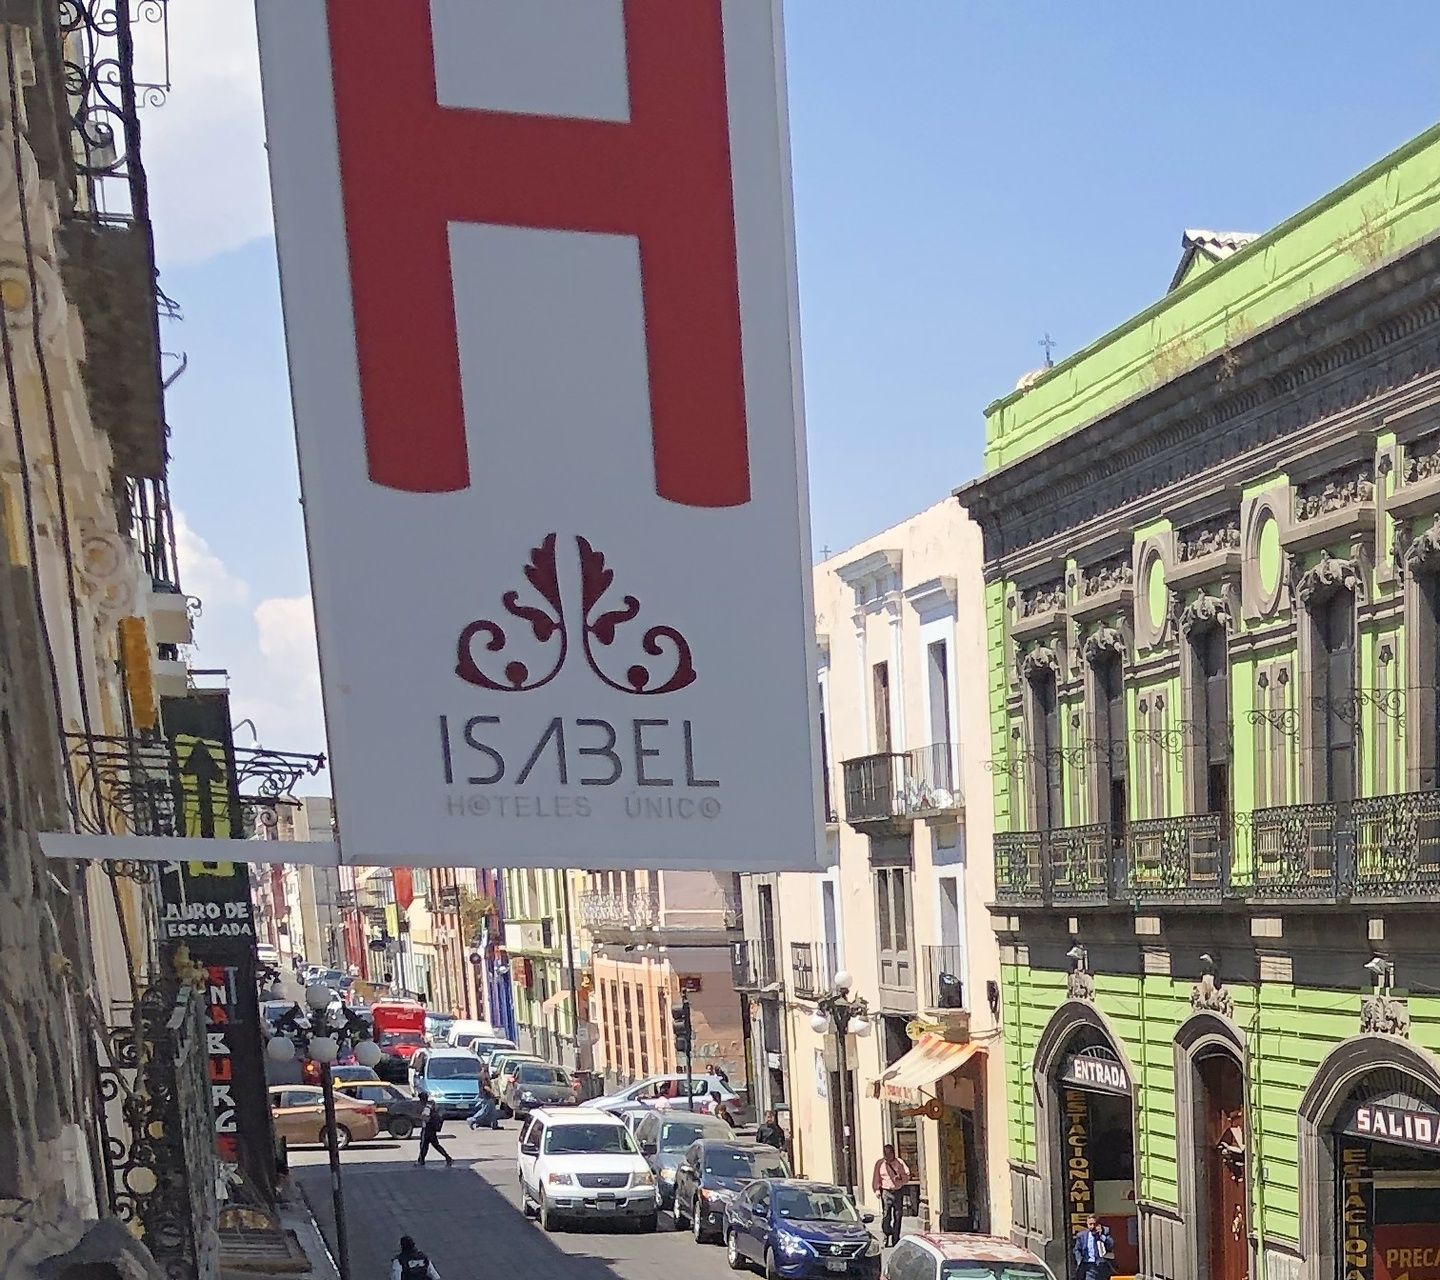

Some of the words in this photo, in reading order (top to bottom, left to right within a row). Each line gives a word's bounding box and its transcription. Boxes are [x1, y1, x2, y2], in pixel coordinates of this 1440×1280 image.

[328, 0, 751, 508] H
[440, 715, 720, 787] ISABEL
[167, 923, 252, 937] ESCALADA
[224, 902, 249, 919] DE
[1073, 1059, 1127, 1089] ENTRADA
[1066, 1091, 1092, 1237] ESTACIONAMIEN
